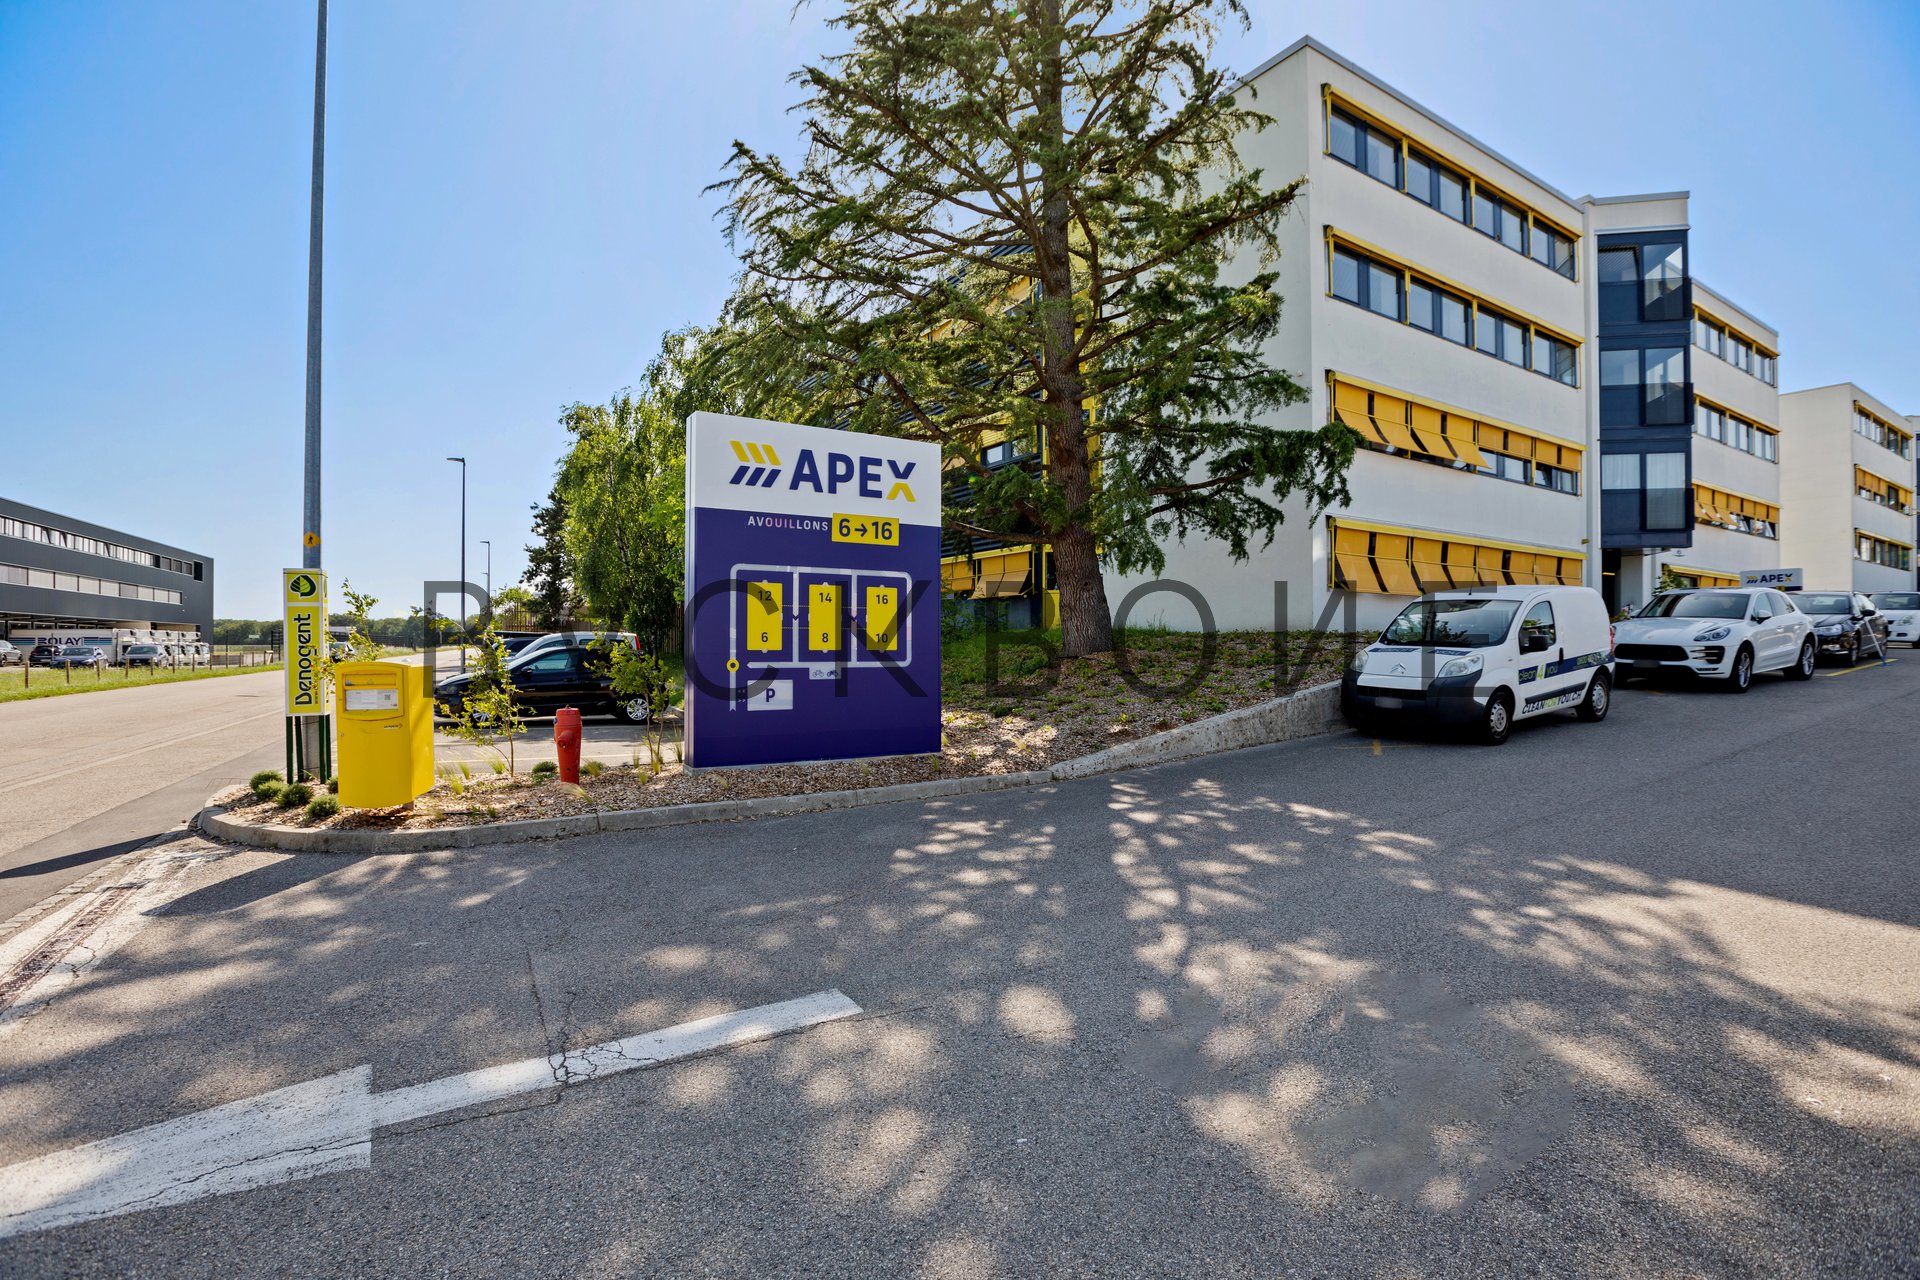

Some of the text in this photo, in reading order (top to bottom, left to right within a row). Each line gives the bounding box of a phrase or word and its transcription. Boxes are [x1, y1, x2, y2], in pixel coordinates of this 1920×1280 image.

[789, 448, 917, 503] APEX
[747, 515, 829, 532] AVOUILLONS
[838, 517, 893, 541] 6 16
[1760, 573, 1793, 583] APEX
[757, 590, 772, 601] 12
[818, 592, 832, 604] 14
[875, 594, 889, 605] 16
[761, 632, 769, 643] 6
[821, 632, 829, 643] 8
[875, 633, 889, 644] 10
[293, 613, 318, 706] Denogent
[765, 688, 776, 702] P
